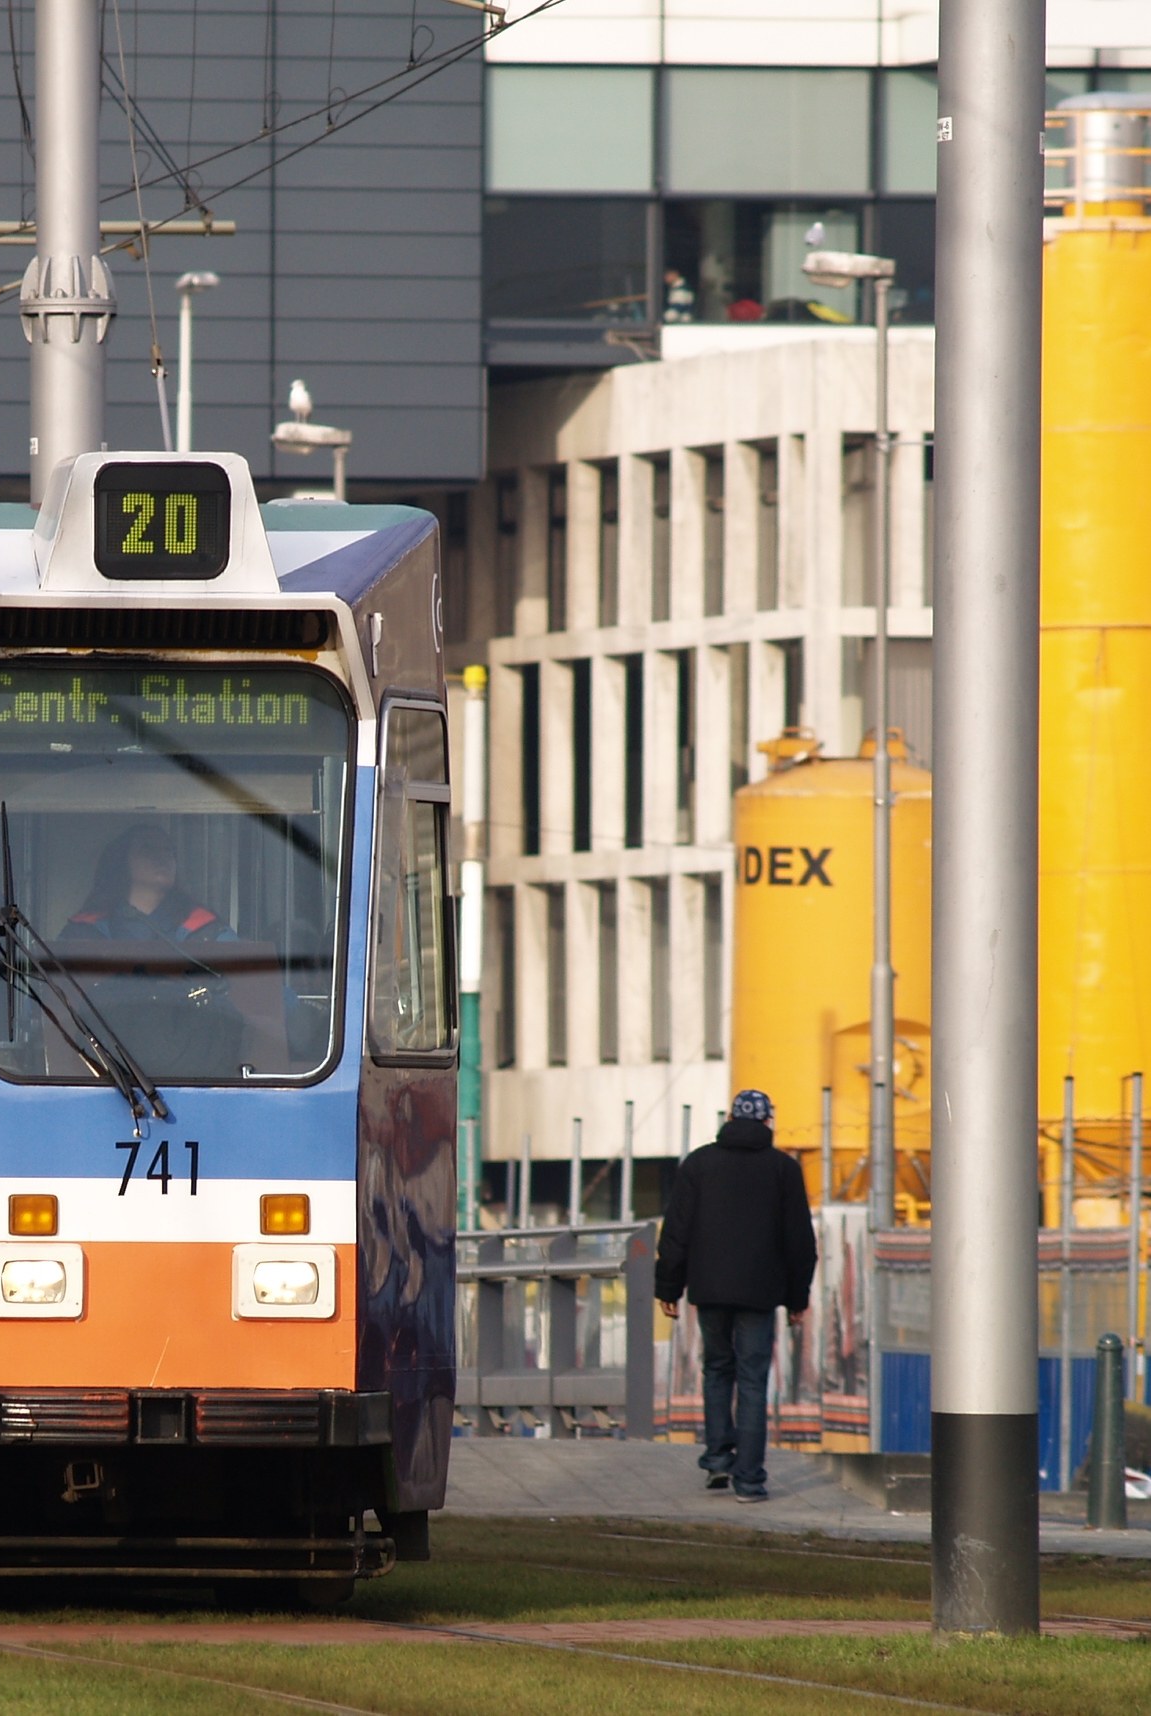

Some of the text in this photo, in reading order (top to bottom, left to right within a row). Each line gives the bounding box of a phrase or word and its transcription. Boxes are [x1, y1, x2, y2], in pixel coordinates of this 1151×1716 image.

[122, 493, 196, 554] 20
[142, 675, 308, 724] Station
[115, 1140, 199, 1196] 741
